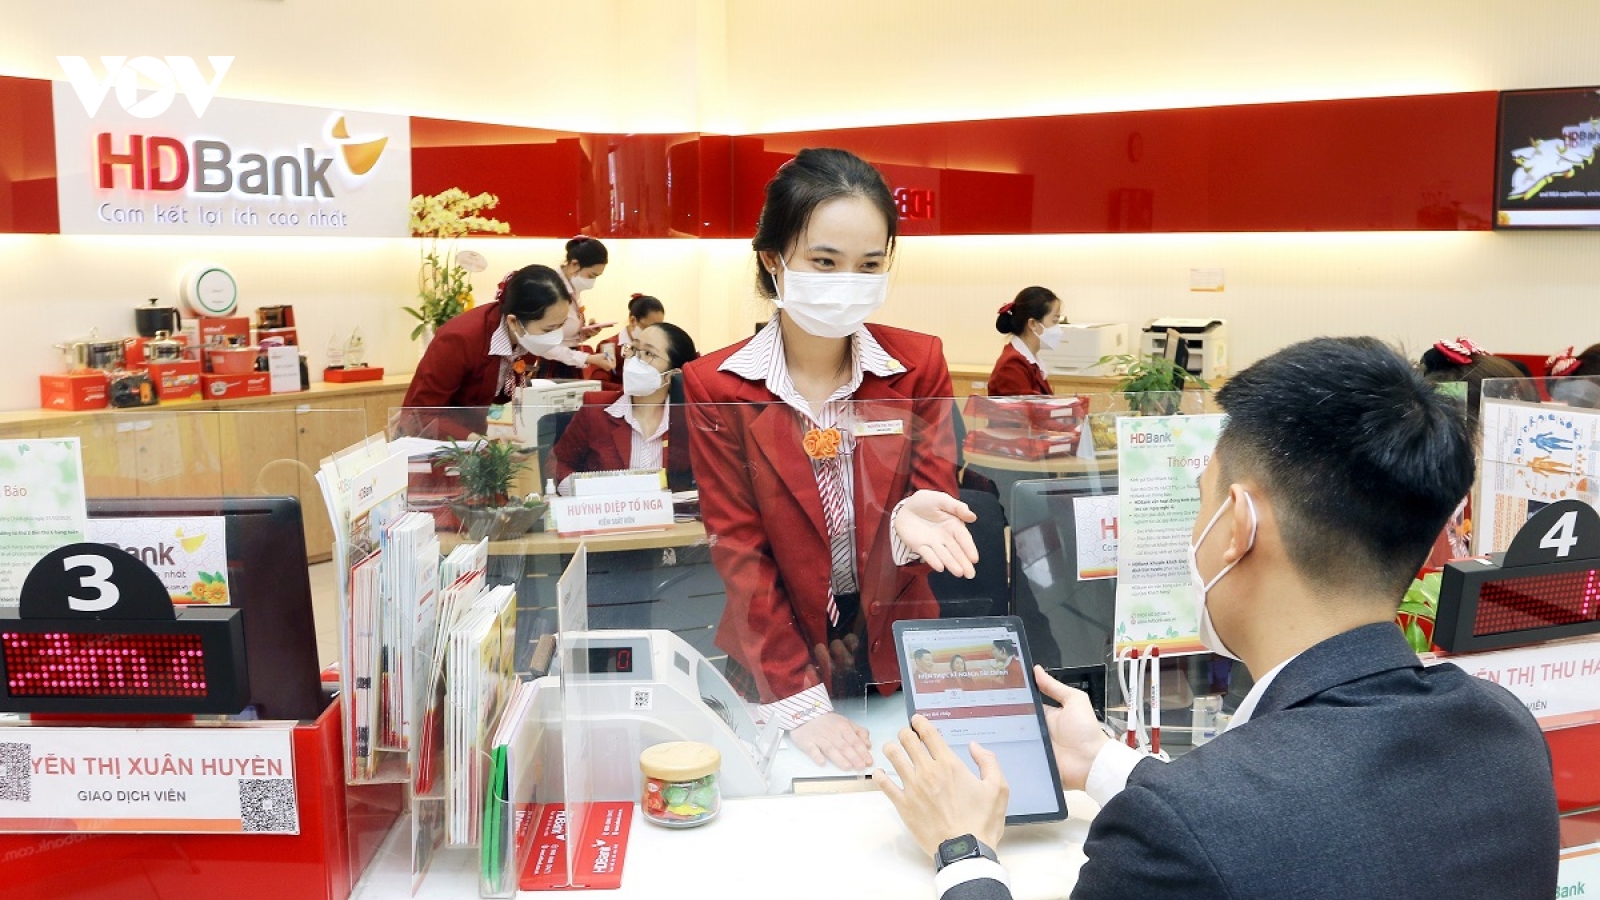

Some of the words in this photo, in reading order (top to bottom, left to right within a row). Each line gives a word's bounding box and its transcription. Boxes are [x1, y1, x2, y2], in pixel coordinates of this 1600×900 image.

[97, 131, 335, 198] HDBank
[99, 203, 145, 224] Cam
[154, 204, 188, 224] kết
[200, 206, 223, 227] lợi
[233, 207, 259, 225] ích
[268, 211, 299, 226] cao
[308, 207, 347, 227] nhất
[1130, 432, 1171, 444] HDBank
[643, 499, 663, 511] NGA
[1539, 511, 1578, 557] 4
[62, 554, 120, 612] 3
[1507, 665, 1536, 688] THỊ
[1541, 661, 1576, 681] THU
[83, 757, 120, 779] THỊ
[127, 752, 194, 776] XUÂN
[77, 790, 113, 801] GIAO
[117, 790, 151, 804] DỊCH
[154, 788, 186, 802] VIÊN
